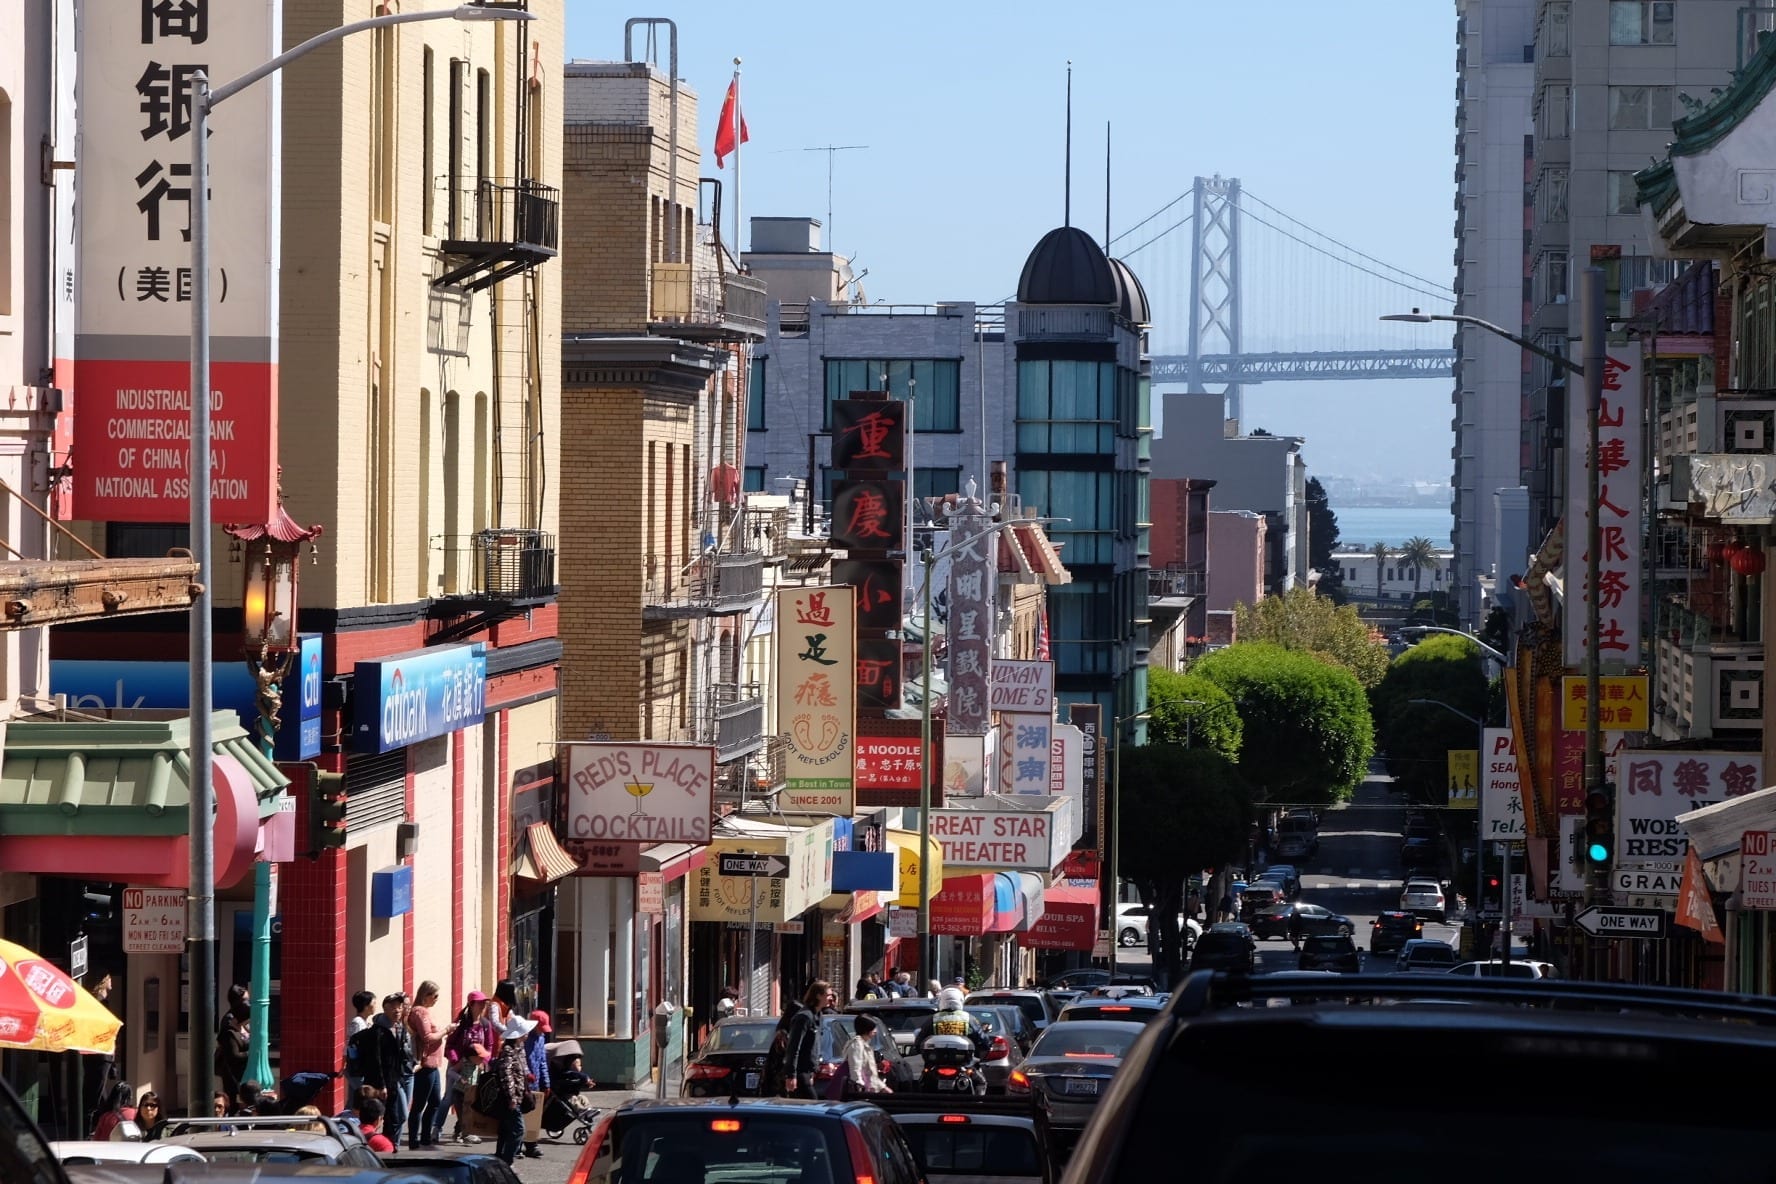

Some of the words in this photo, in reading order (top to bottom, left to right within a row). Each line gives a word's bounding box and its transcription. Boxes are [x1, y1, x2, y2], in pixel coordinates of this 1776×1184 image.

[116, 389, 192, 411] INDUSTRIAL
[107, 418, 191, 440] COMMERCIAL
[118, 447, 136, 469] OF
[142, 448, 182, 470] CHINA
[95, 477, 158, 498] NATIONAL
[384, 678, 428, 745] citibank
[797, 732, 849, 766] REFLEXOLOGY
[857, 745, 865, 755] &
[572, 751, 632, 796] RED'S
[641, 750, 708, 797] PLACE
[830, 781, 851, 789] Town
[1490, 780, 1519, 792] Hong
[790, 796, 819, 804] SINCE
[820, 796, 842, 805] 2001
[574, 814, 707, 840] COCKTAILS
[993, 817, 1046, 838] STAR
[941, 841, 1027, 863] THEATER
[1745, 834, 1767, 854] NO
[726, 860, 745, 870] ONE
[748, 860, 769, 871] WAY
[1748, 881, 1769, 893] TUES
[125, 891, 142, 908] NO
[146, 895, 184, 907] PARKING
[1066, 914, 1085, 923] SPA
[1600, 916, 1624, 928] ONE
[1630, 917, 1656, 929] WAY
